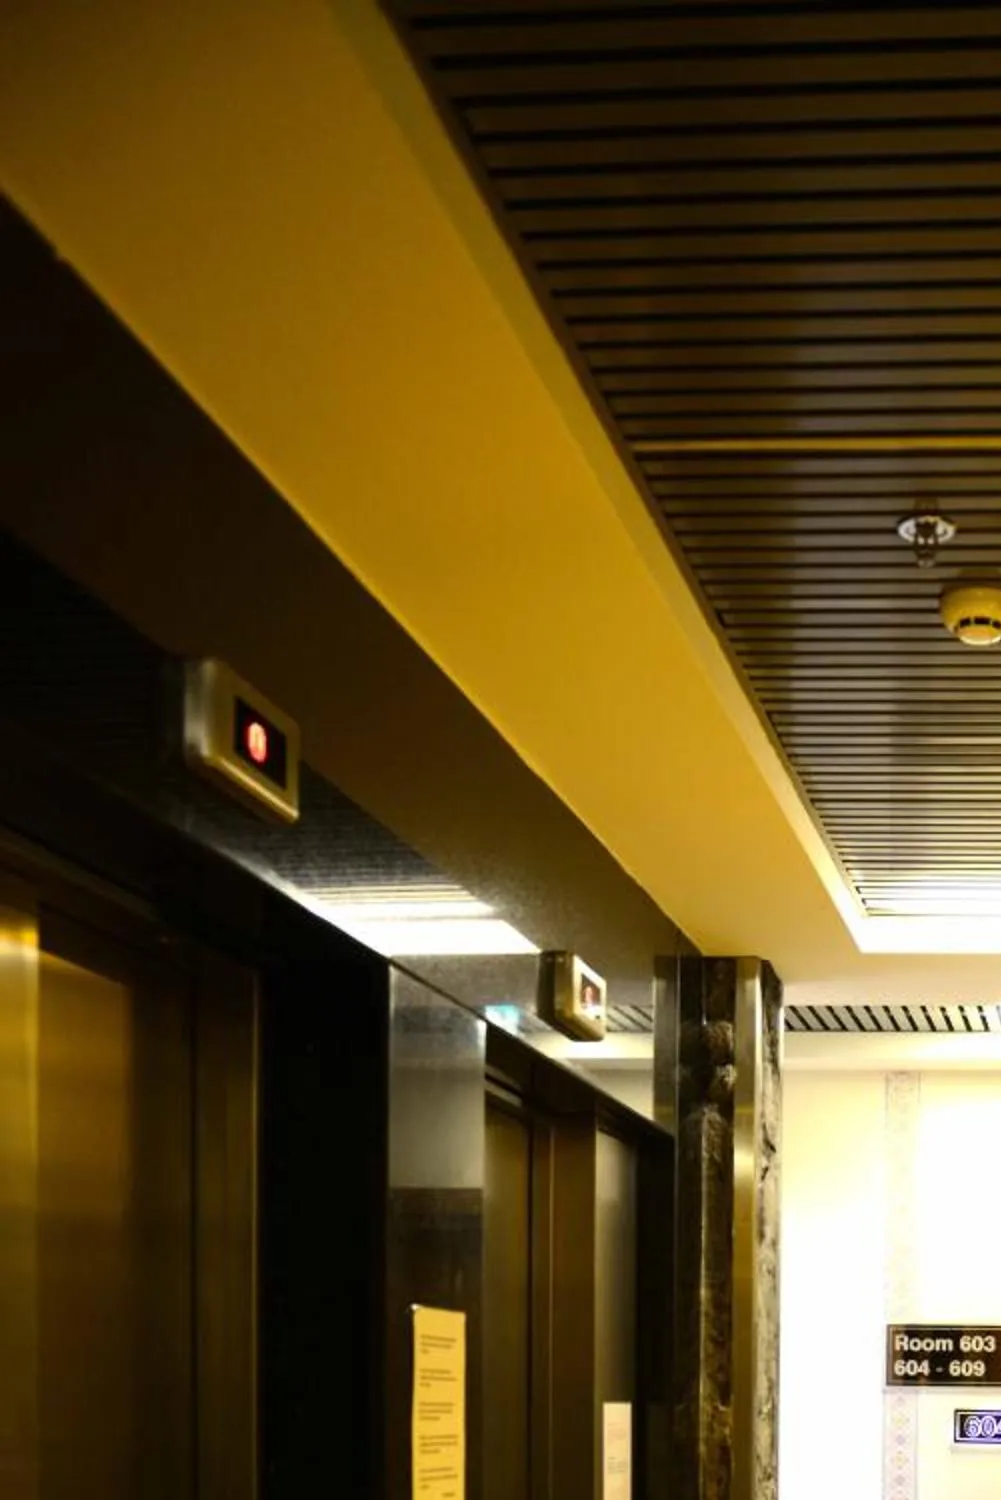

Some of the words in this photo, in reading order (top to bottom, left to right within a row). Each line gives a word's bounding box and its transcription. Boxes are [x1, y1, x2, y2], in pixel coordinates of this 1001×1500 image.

[894, 1333, 954, 1352] Room
[959, 1335, 996, 1352] 603
[893, 1359, 930, 1376] 604
[949, 1360, 986, 1377] 609
